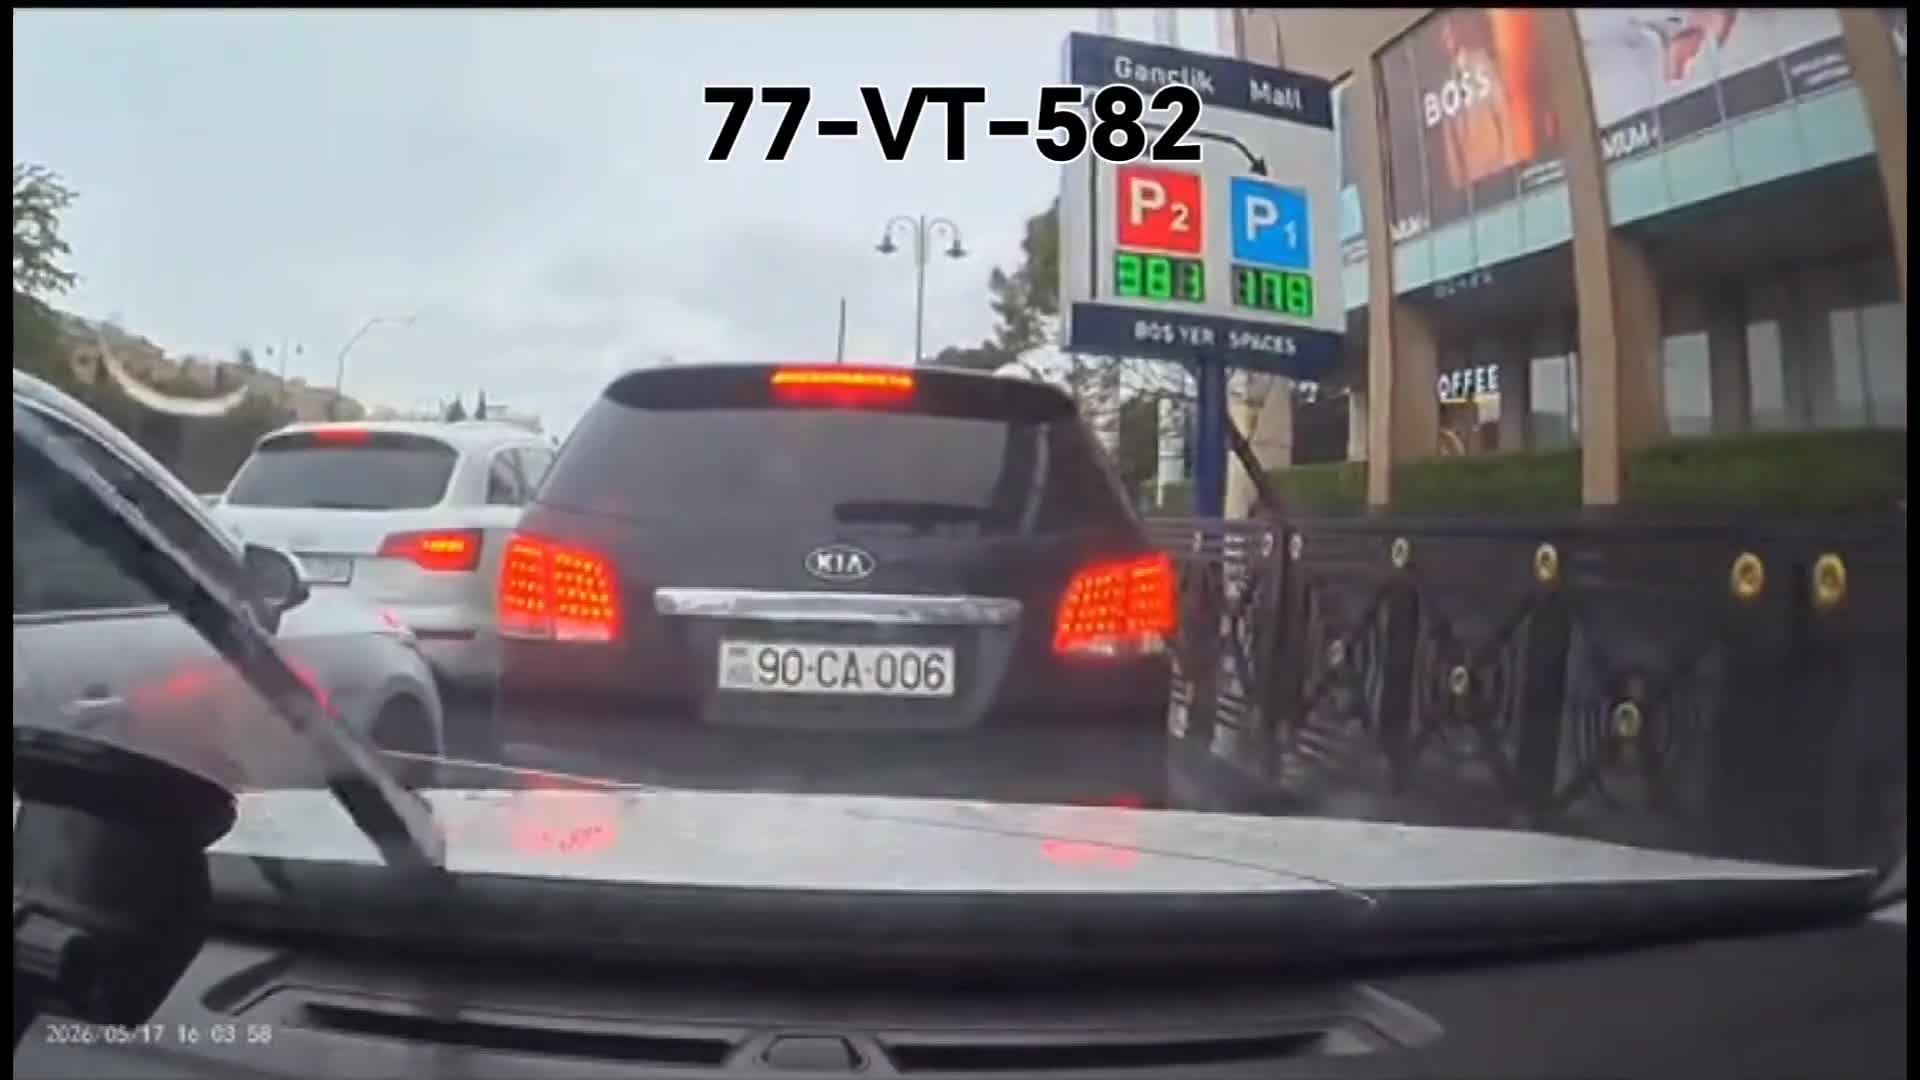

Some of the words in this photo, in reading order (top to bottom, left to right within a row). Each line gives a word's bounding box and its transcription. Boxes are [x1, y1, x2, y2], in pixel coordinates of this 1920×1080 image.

[1250, 78, 1304, 111] Mall
[1424, 69, 1493, 128] BOSS
[1178, 324, 1215, 346] YER
[1228, 331, 1297, 356] SPACES
[816, 553, 864, 574] KIA
